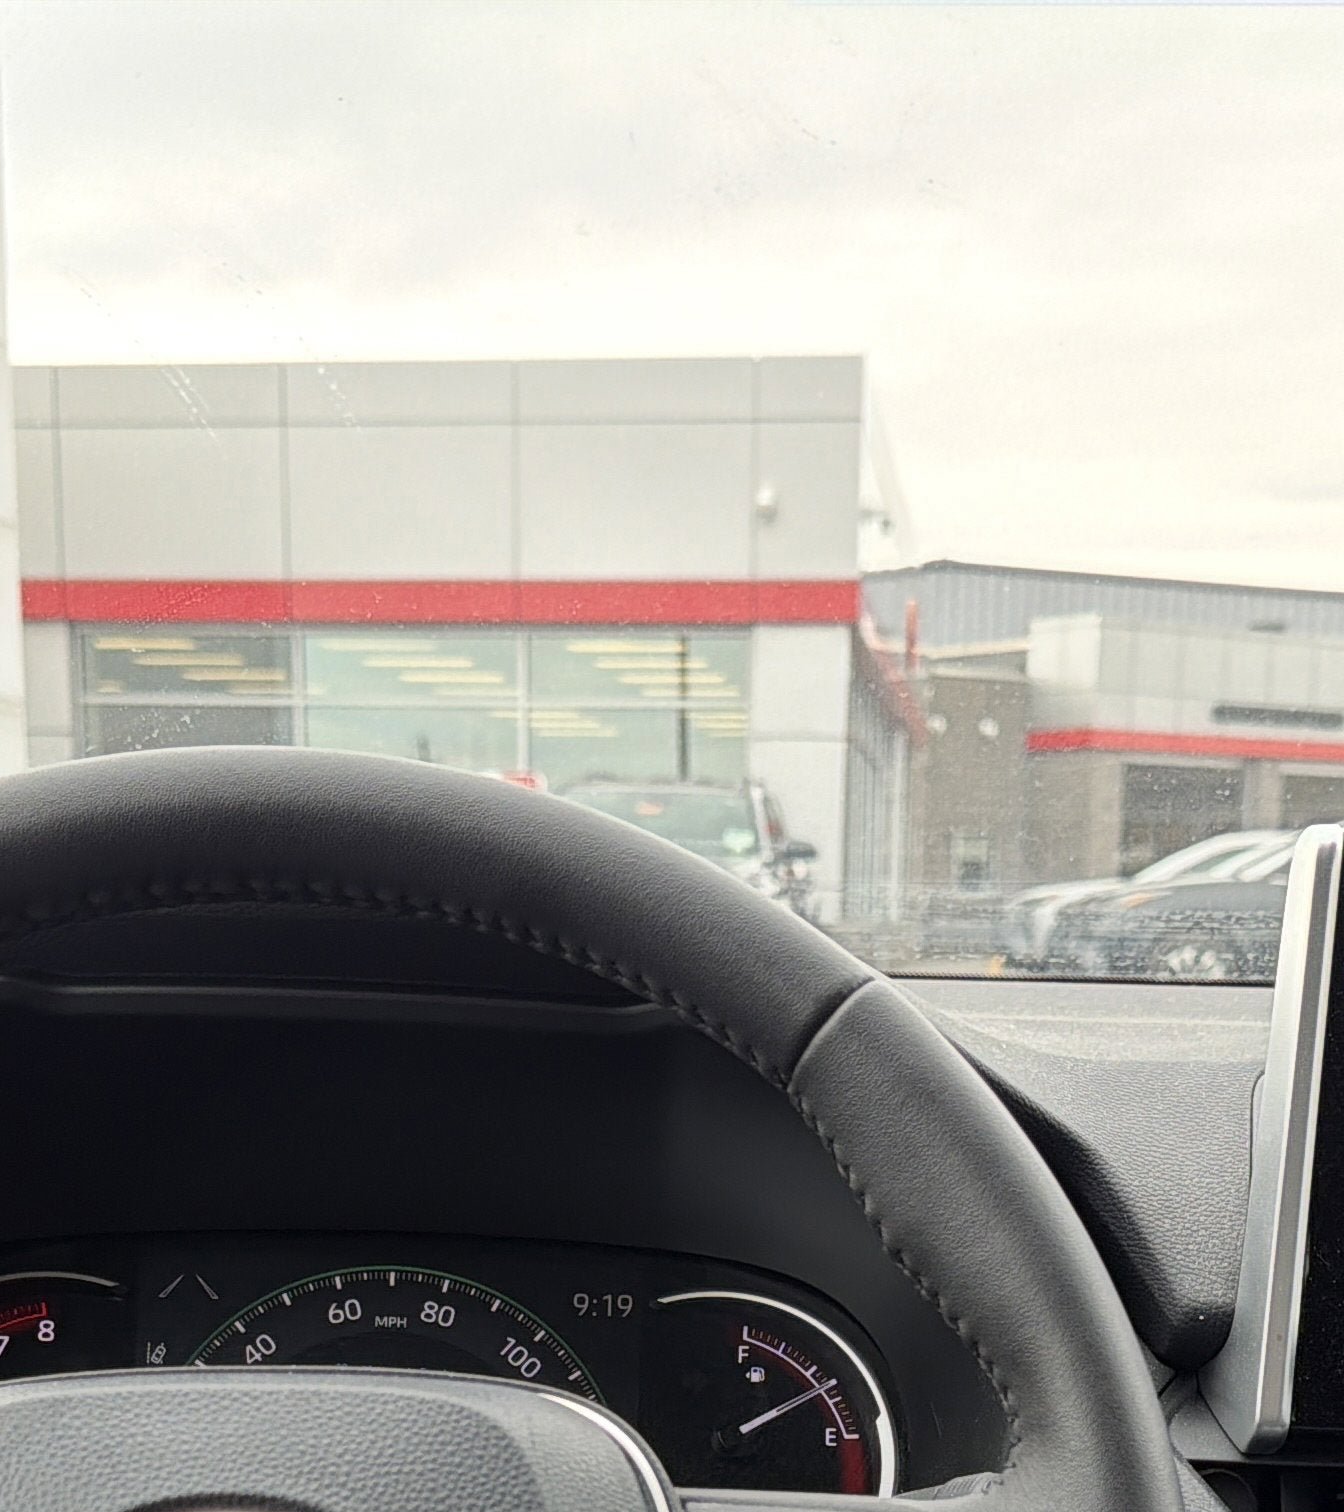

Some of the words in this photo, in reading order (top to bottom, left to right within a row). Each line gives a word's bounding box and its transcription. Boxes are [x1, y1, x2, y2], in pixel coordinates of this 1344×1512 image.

[327, 1298, 363, 1325] 60
[420, 1300, 455, 1328] 80
[572, 1293, 634, 1319] 9:19
[37, 1319, 55, 1342] 8
[374, 1314, 407, 1329] MPH
[244, 1333, 277, 1366] 40
[499, 1336, 543, 1379] 100
[738, 1345, 750, 1364] F
[825, 1428, 837, 1447] E
